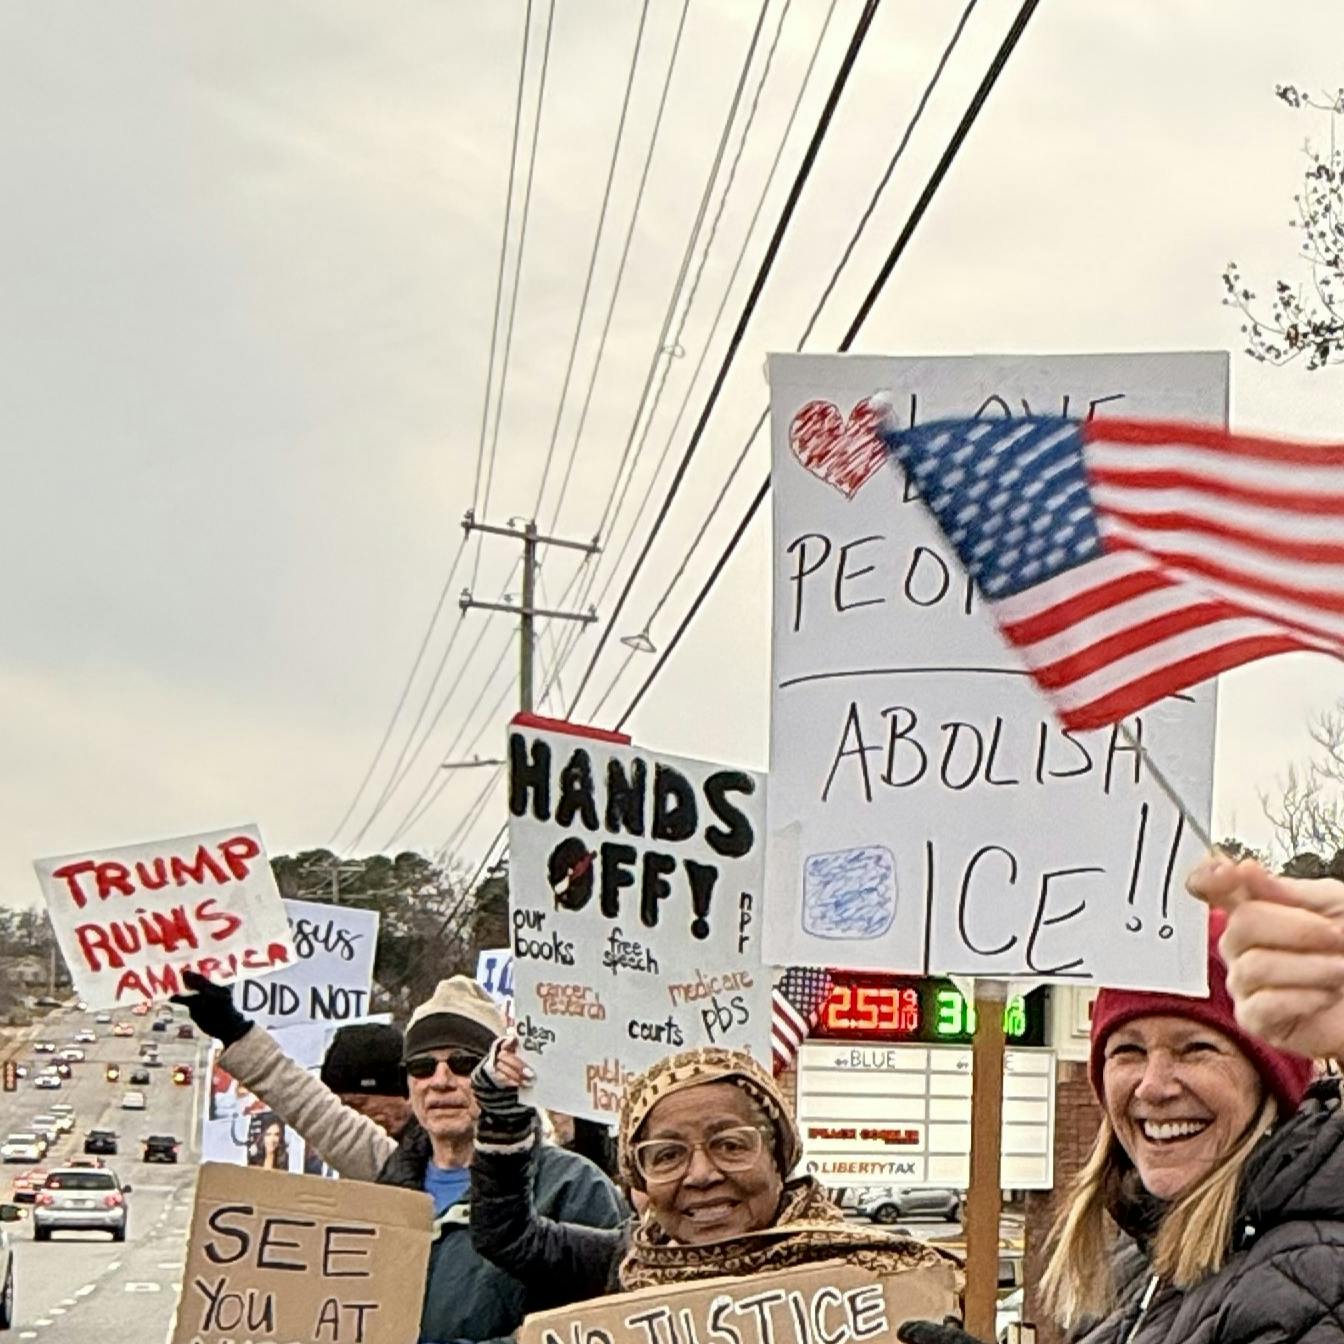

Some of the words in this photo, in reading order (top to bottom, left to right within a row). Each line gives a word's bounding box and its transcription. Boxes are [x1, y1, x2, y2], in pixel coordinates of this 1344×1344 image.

[786, 533, 977, 633] PEO
[822, 701, 1147, 803] ABOLISH
[508, 733, 756, 858] HANDS
[52, 836, 260, 908] TRUMP
[547, 836, 720, 940] OFF!
[289, 918, 364, 961] sus
[513, 909, 546, 931] our
[607, 926, 643, 956] free
[514, 930, 575, 966] books
[602, 948, 660, 976] speech
[116, 943, 289, 1001] AMRICA
[668, 968, 754, 1007] medicare
[243, 979, 300, 1015] DID
[310, 984, 368, 1020] NOT
[516, 1014, 556, 1043] clean
[628, 1015, 684, 1047] courts
[850, 1050, 896, 1069] BLUE
[204, 1206, 377, 1277] SEE
[195, 1277, 274, 1332] YOU
[315, 1298, 379, 1343] AT
